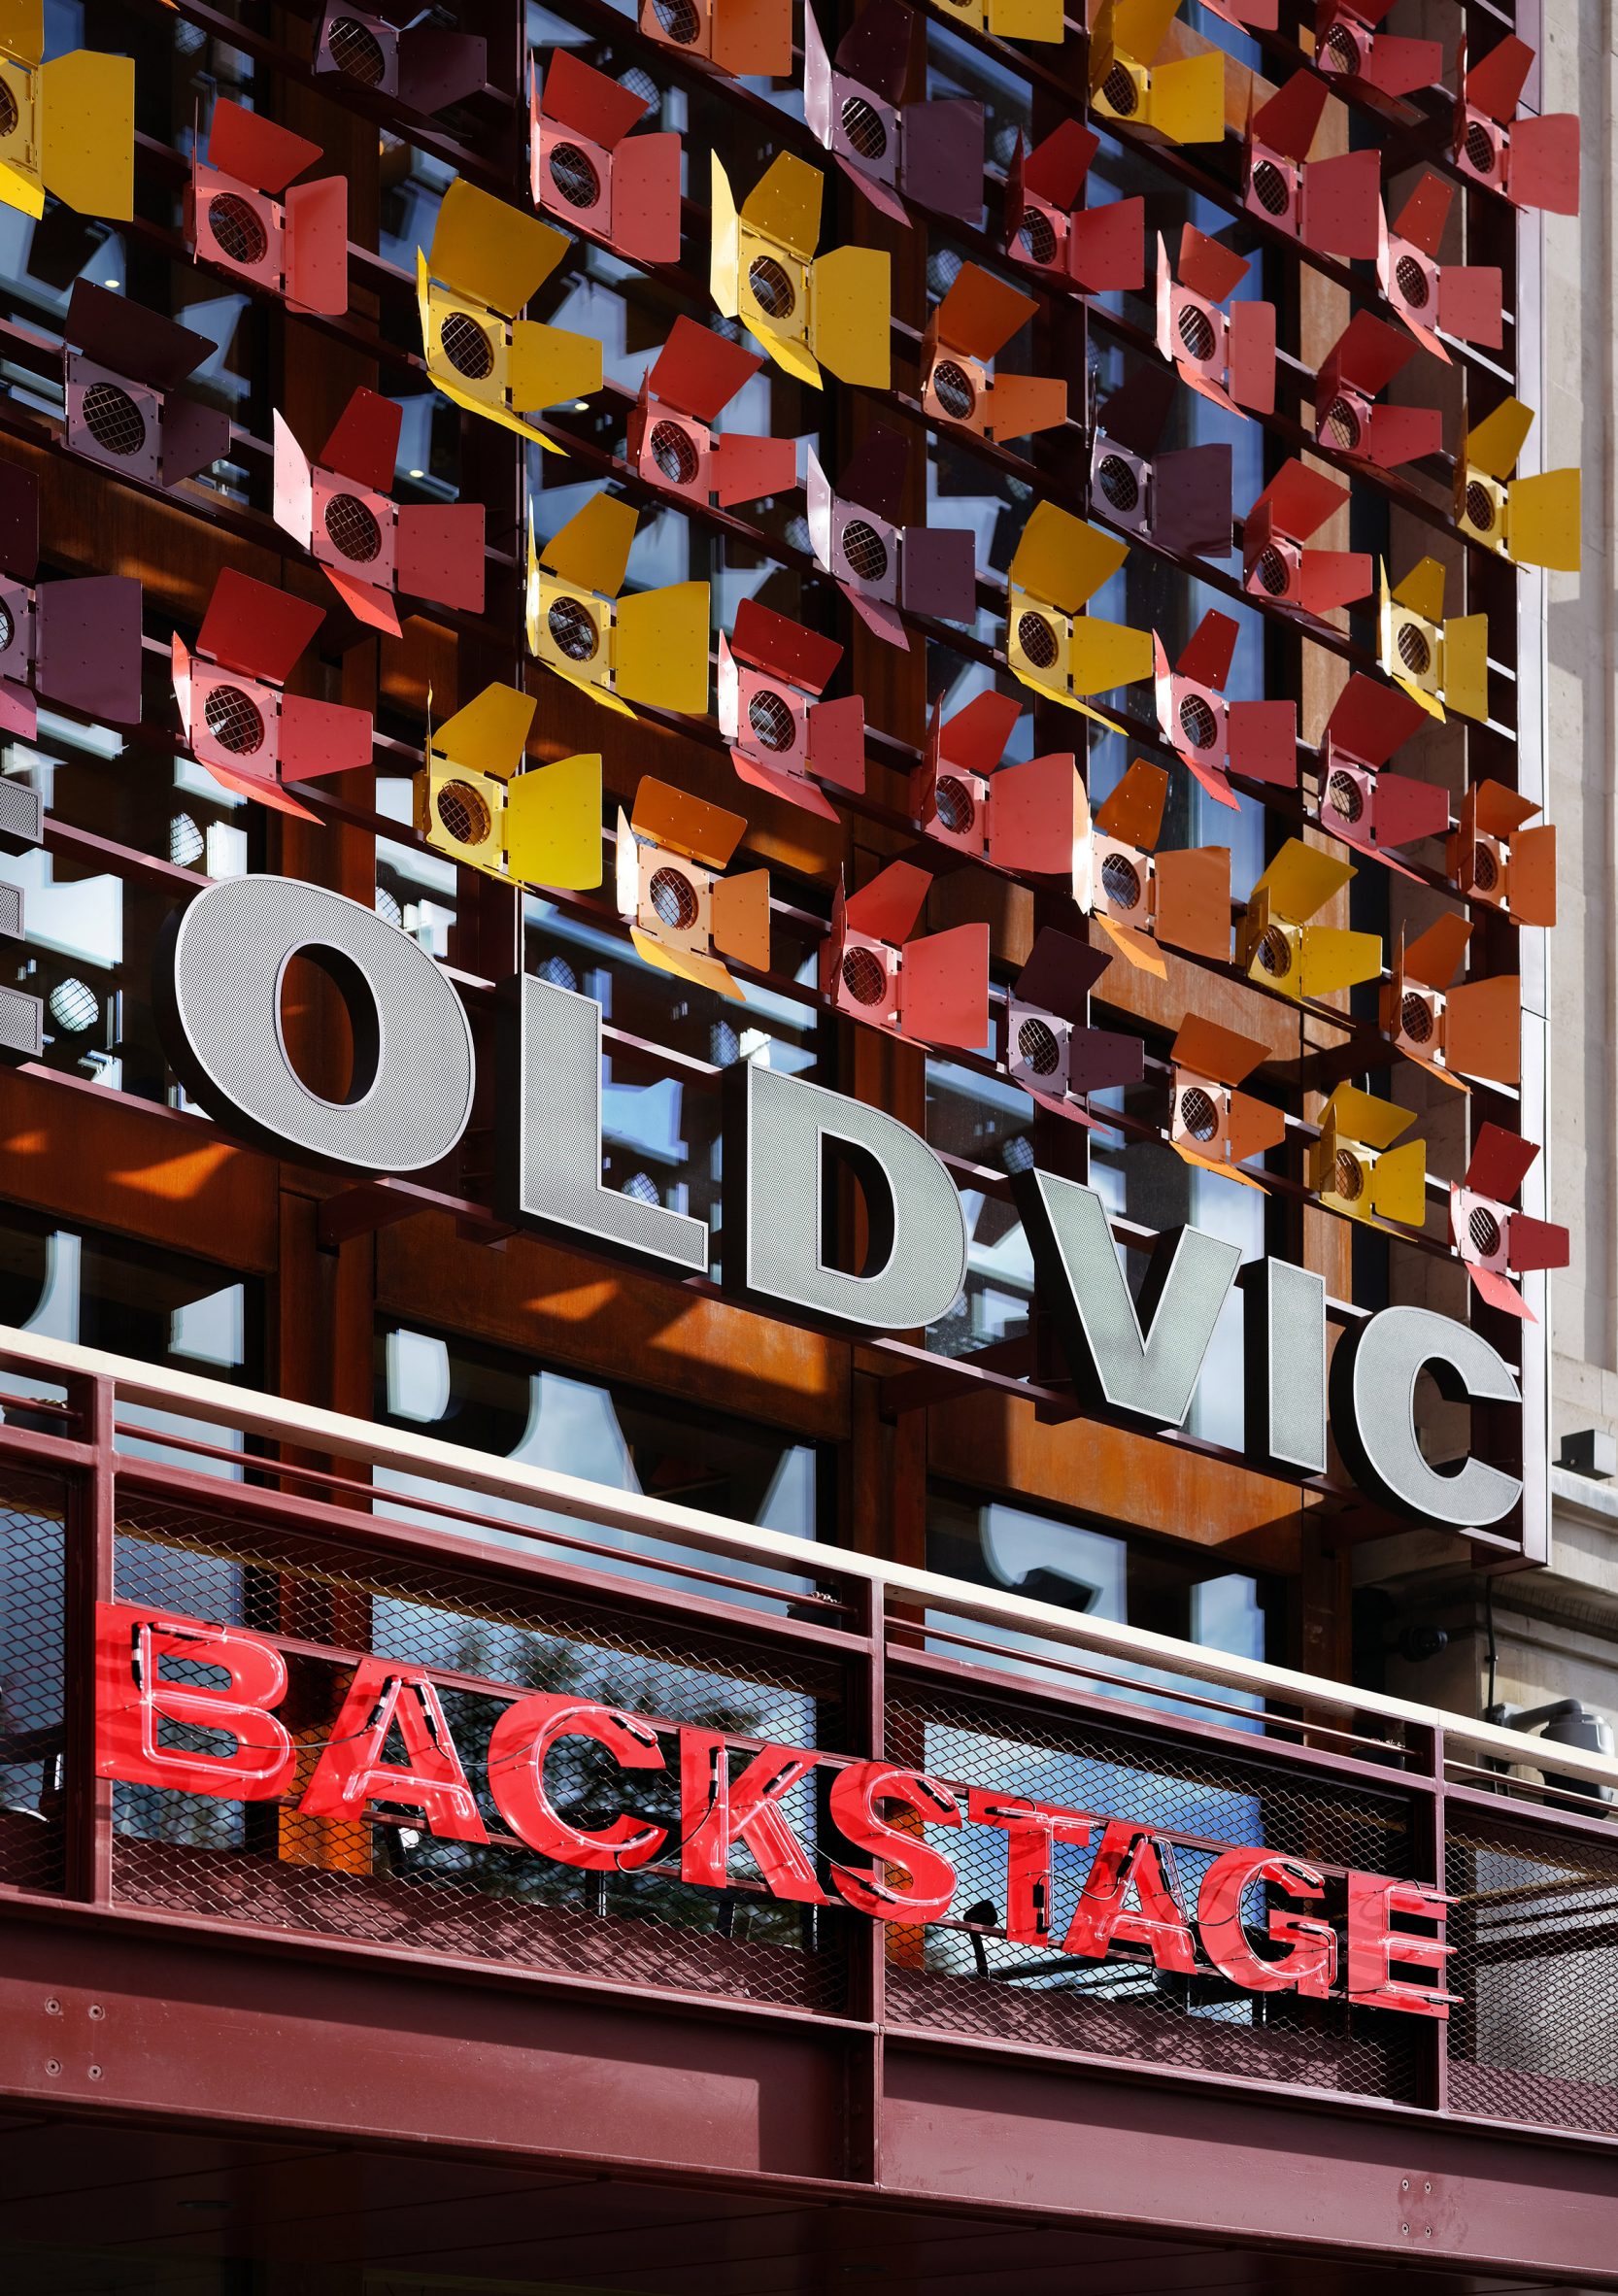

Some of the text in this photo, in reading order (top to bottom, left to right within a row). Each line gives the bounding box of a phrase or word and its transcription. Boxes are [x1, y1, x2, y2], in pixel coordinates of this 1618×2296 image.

[173, 873, 968, 1330] OLD
[1032, 1167, 1523, 1527] VIC
[95, 1601, 1465, 2019] BACKSTAGE
